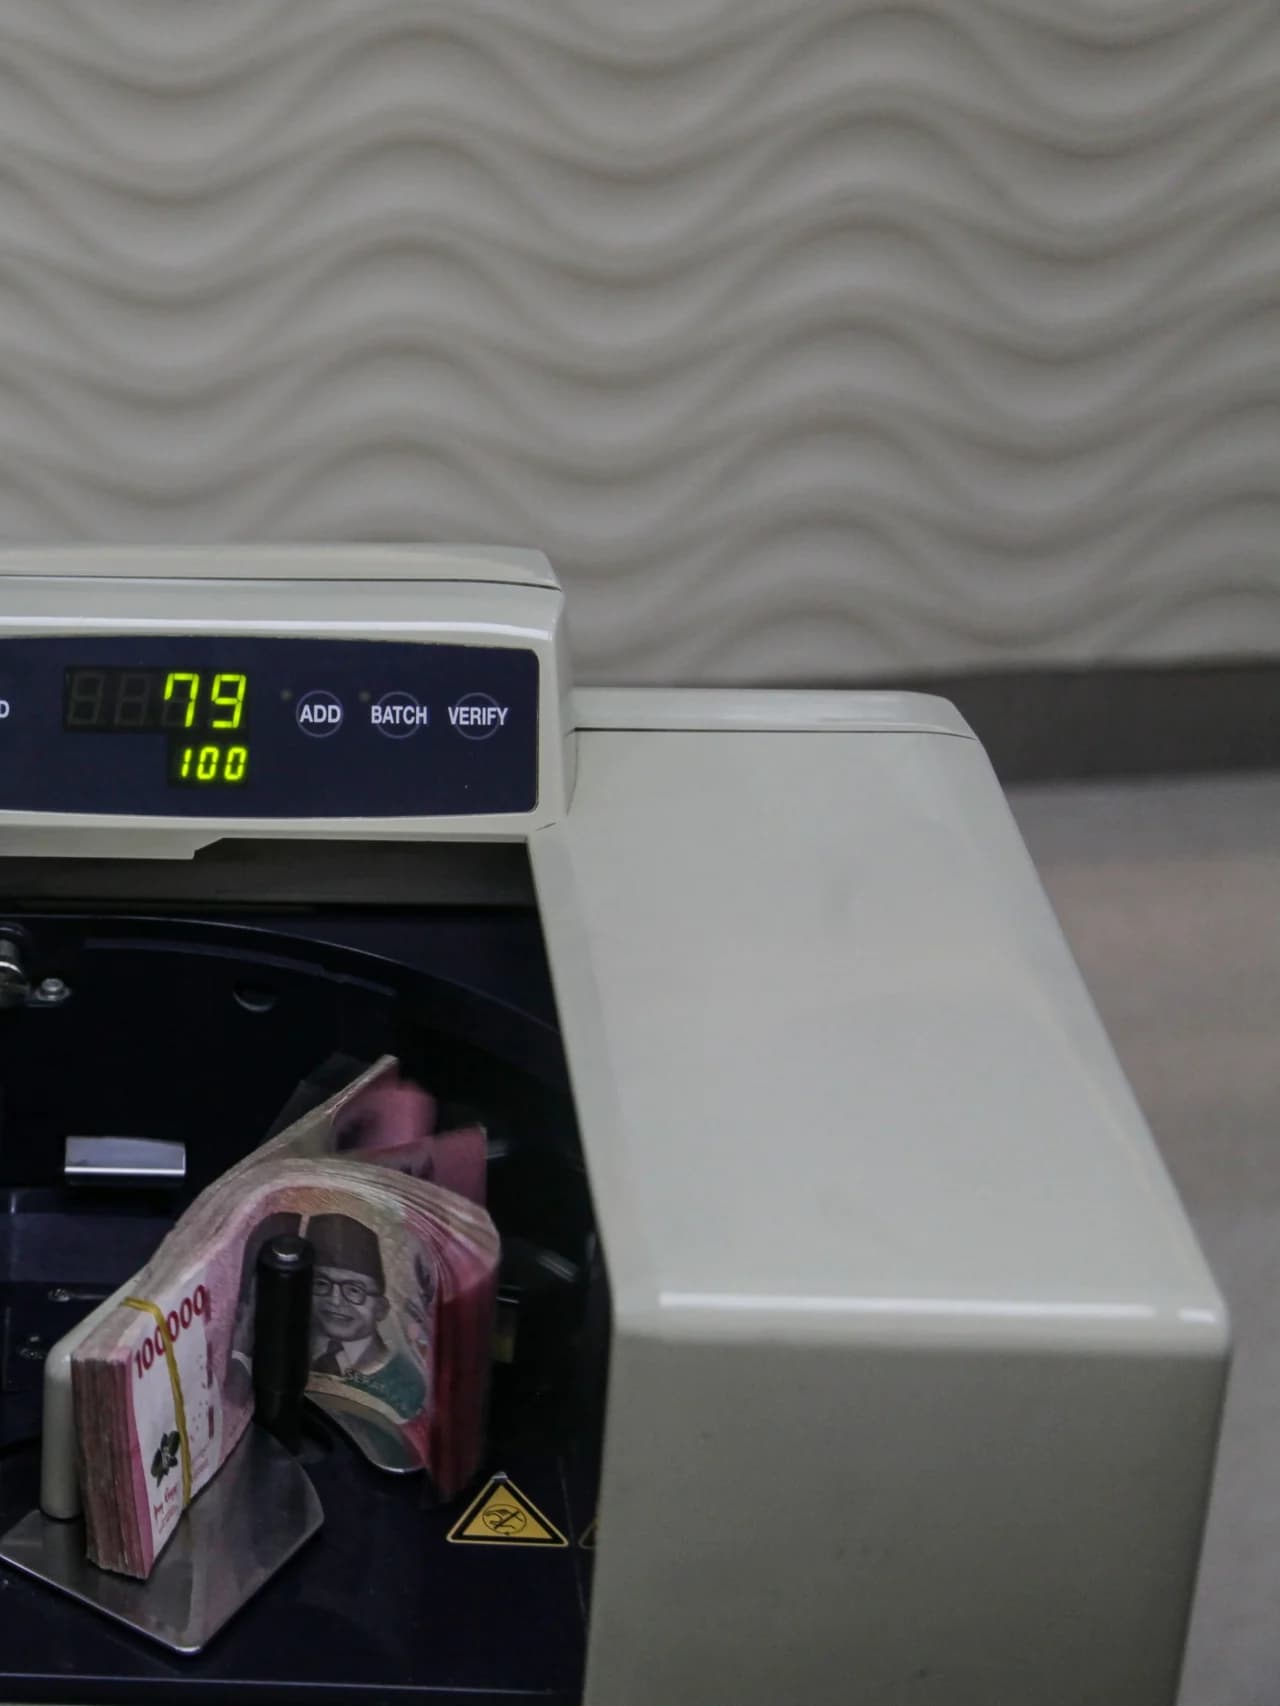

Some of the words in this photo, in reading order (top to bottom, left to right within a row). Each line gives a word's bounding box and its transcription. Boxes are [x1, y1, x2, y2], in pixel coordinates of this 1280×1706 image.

[164, 672, 246, 728] 79
[299, 704, 342, 723] ADD
[370, 704, 428, 725] BATCH
[447, 706, 509, 726] VERIFY
[181, 746, 246, 780] 100
